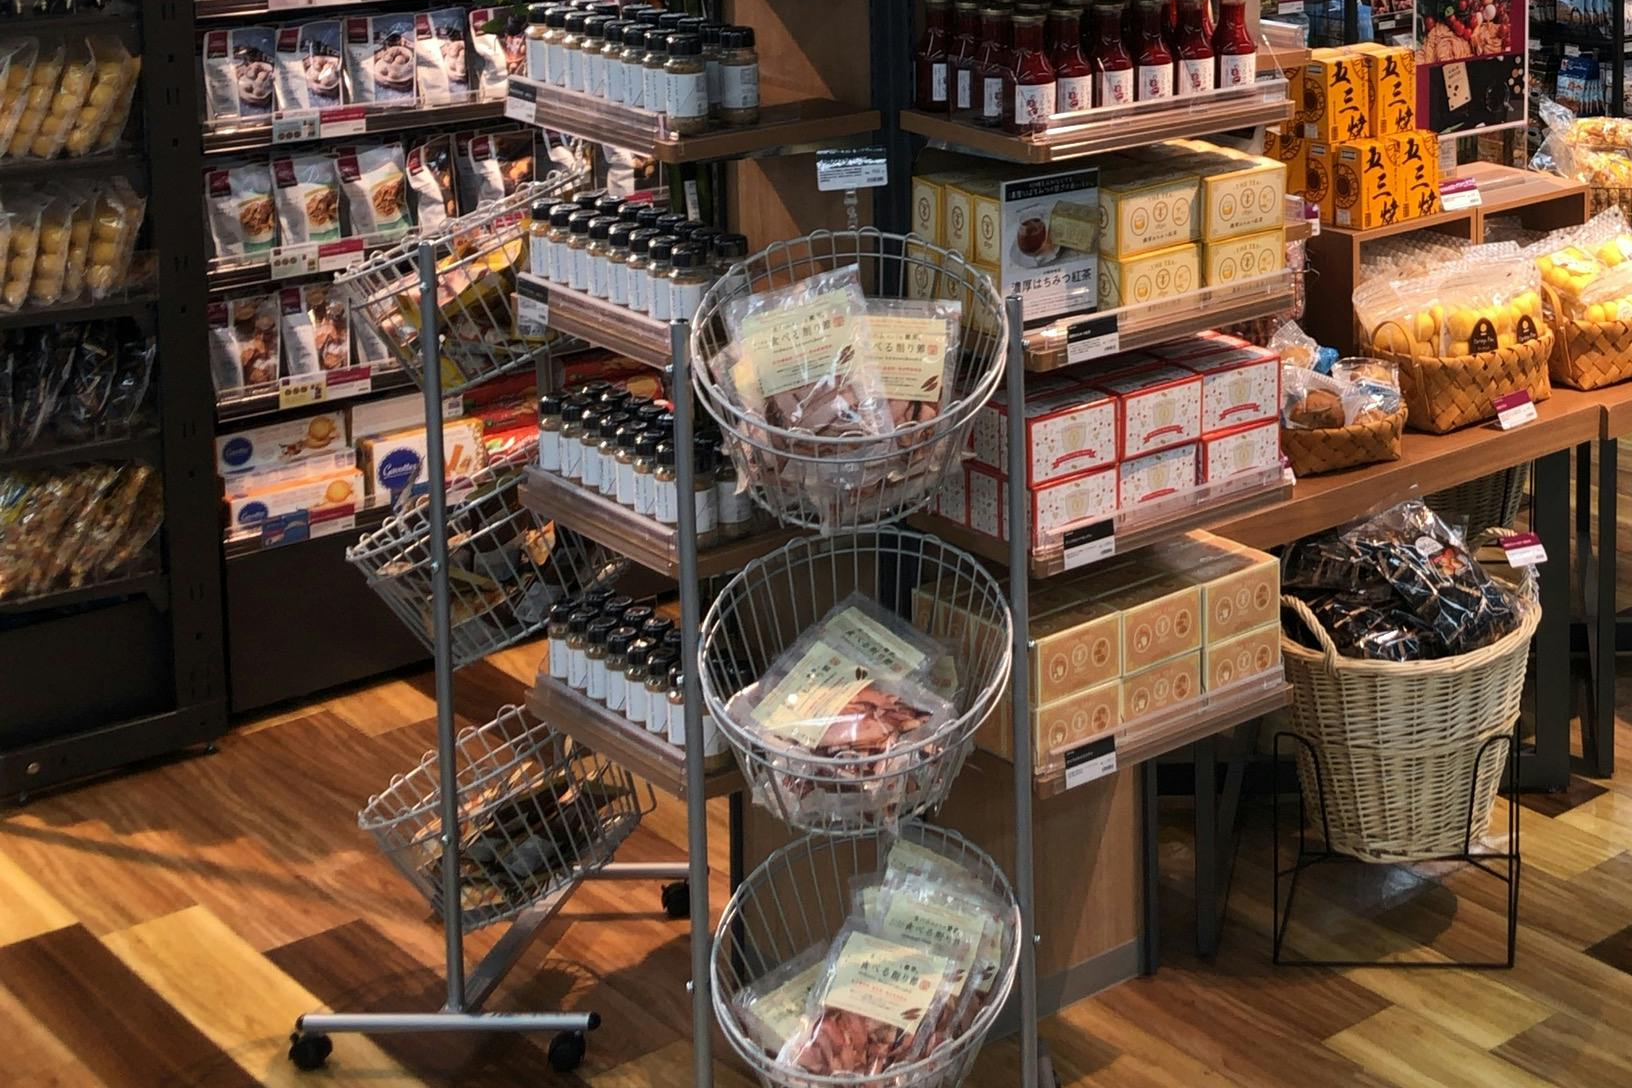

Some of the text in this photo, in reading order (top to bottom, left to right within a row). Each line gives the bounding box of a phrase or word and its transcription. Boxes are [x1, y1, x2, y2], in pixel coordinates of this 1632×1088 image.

[1011, 268, 1092, 294] 濃厚はちみつ紅茶
